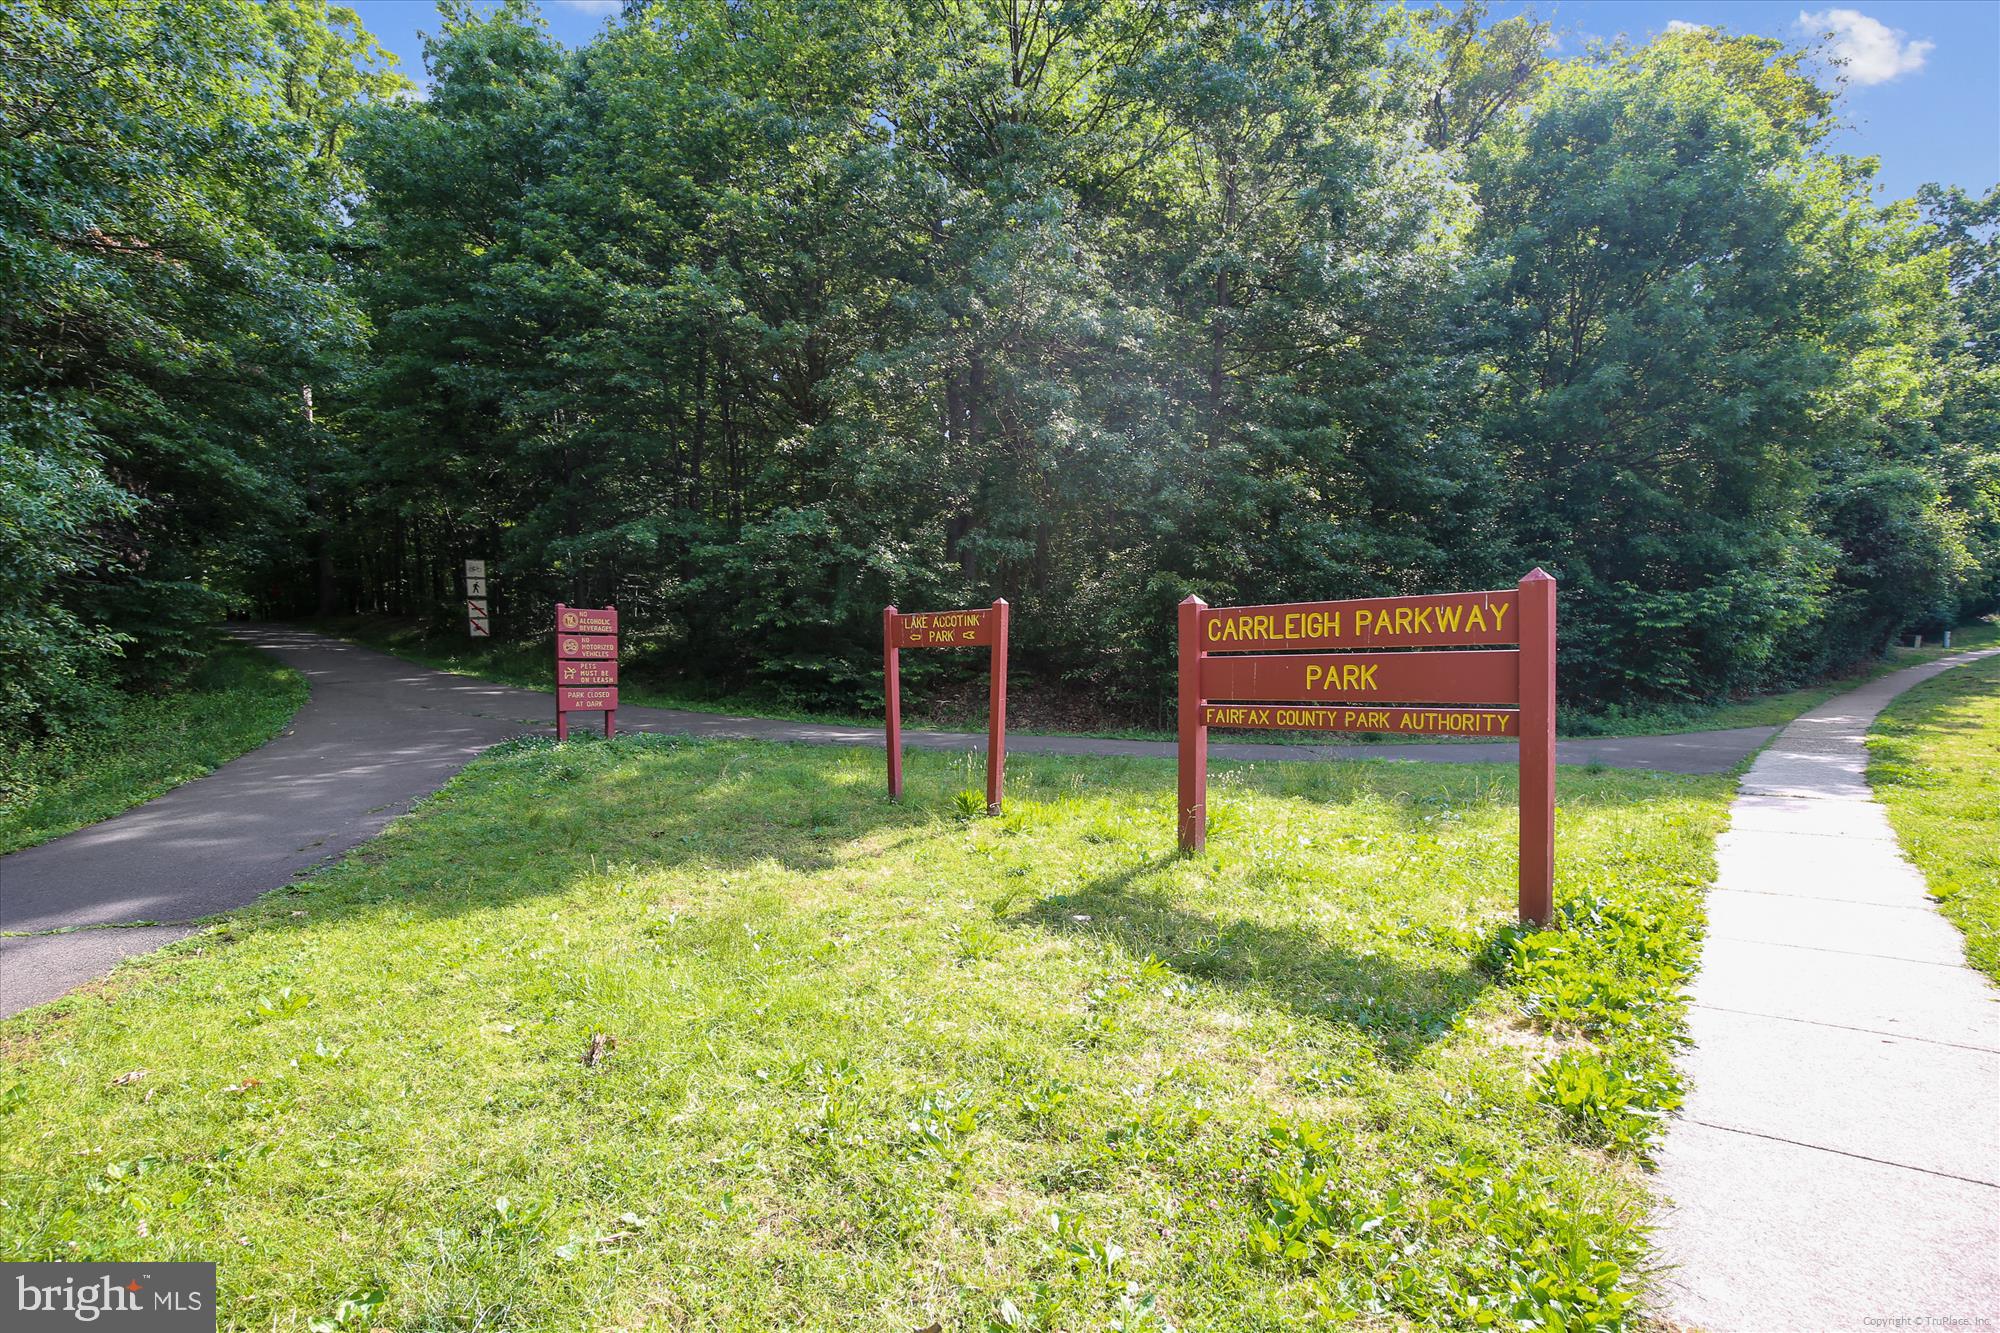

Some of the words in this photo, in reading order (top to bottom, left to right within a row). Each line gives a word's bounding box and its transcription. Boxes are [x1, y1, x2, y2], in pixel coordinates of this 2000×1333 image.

[904, 616, 928, 629] LAKE
[932, 615, 980, 628] ACCOTINK
[1207, 611, 1341, 642] CARRLEIGH
[1355, 602, 1510, 634] PARKWAY
[929, 631, 954, 642] PARK
[1306, 664, 1378, 690] PARK
[1206, 709, 1270, 725] FAIRFAX
[1276, 710, 1338, 727] COUNTY
[1344, 711, 1390, 728] PARK
[1400, 712, 1510, 732] AUTHORITY
